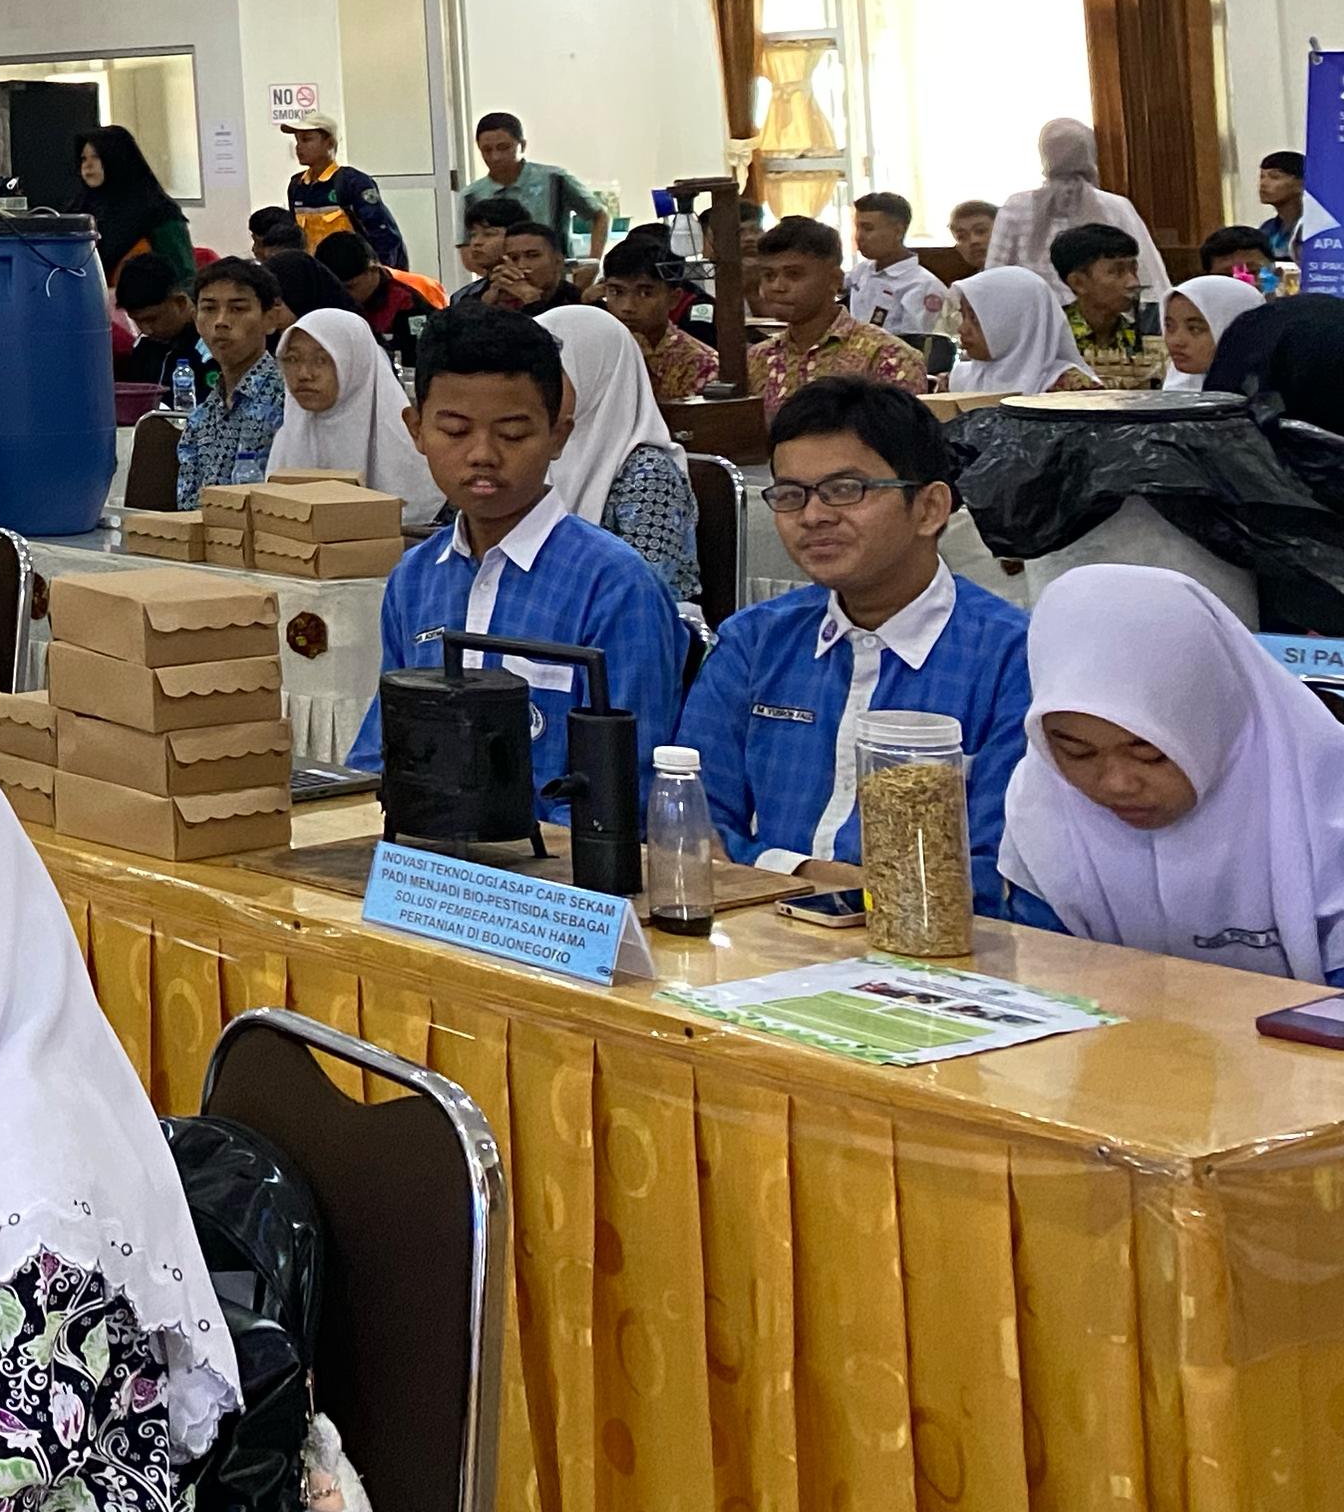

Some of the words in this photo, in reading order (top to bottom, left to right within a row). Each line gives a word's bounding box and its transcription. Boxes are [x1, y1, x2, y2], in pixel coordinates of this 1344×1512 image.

[272, 88, 293, 105] NO
[1314, 238, 1343, 249] APA
[1284, 648, 1306, 664] SI
[1314, 650, 1344, 667] PA
[381, 868, 407, 884] PADI
[410, 875, 460, 898] MENJADI
[463, 888, 549, 920] BIO-PESTISIDA
[552, 910, 610, 935] SEBAGAI
[382, 851, 428, 871] INOVASI
[431, 862, 498, 889] TEKNOLOGI
[500, 879, 533, 896] ASAP
[536, 888, 566, 905] CAIR
[570, 896, 616, 917] SEKAM
[394, 890, 437, 908] SOLUSI
[439, 901, 546, 938] PEMBERANTASAN
[549, 929, 586, 949] HAMA
[399, 909, 465, 935] PERTANIAN
[467, 926, 480, 940] DI
[482, 931, 571, 964] BOJONEGORO
